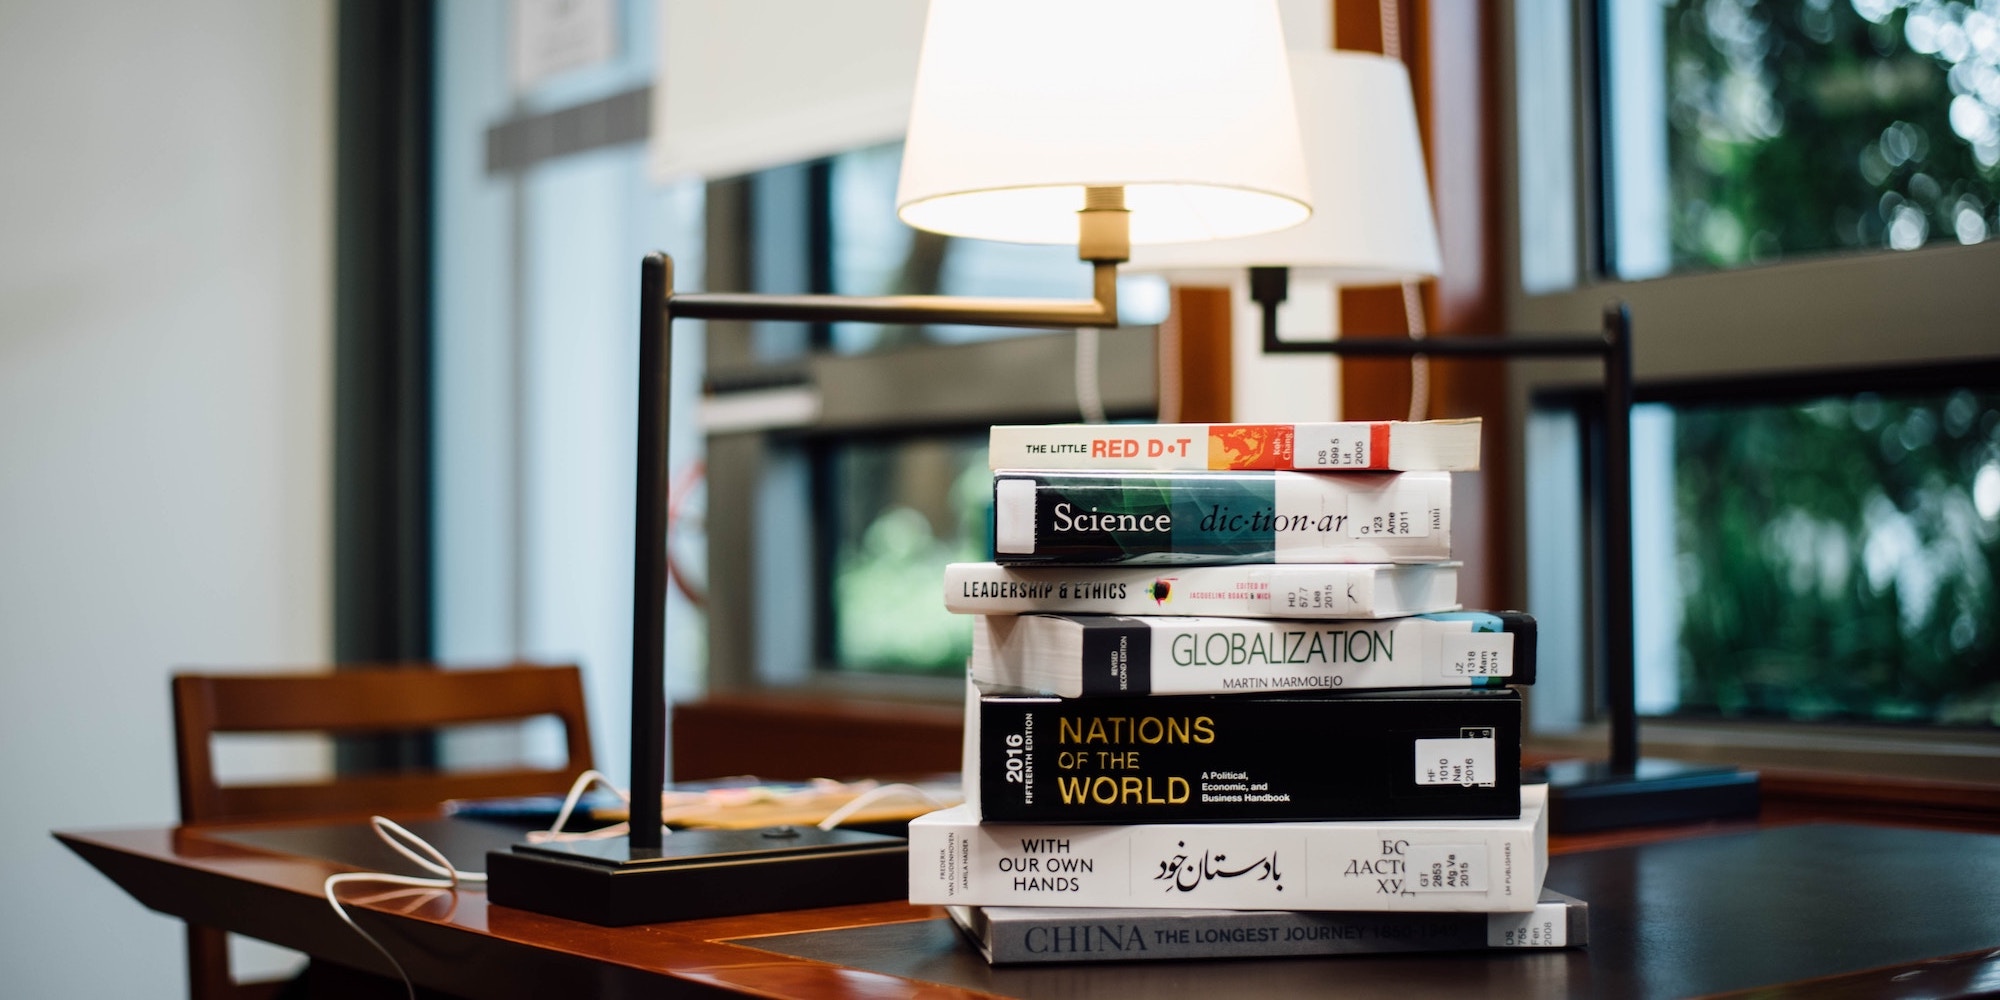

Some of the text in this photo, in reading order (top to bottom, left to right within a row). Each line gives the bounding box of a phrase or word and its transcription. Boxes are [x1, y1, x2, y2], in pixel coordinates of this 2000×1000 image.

[1026, 444, 1047, 454] THE
[1050, 444, 1088, 454] LITTLE
[1091, 439, 1140, 458] RED
[1273, 438, 1281, 456] Koh
[1355, 440, 1364, 465] 2005
[1318, 450, 1327, 465] DS
[1343, 453, 1352, 465] Lit
[1053, 503, 1171, 532] Science
[1374, 516, 1383, 534] 123
[1387, 511, 1396, 535] Ame
[1400, 511, 1409, 534] 2011
[1361, 526, 1370, 535] Q
[963, 581, 1127, 600] LEADERSHIP & ETHICS
[1236, 582, 1258, 590] EDITED
[1288, 592, 1296, 608] HD
[1312, 590, 1322, 608] Lea
[1324, 584, 1333, 608] 2015
[1171, 630, 1394, 666] GLOBALIZATION
[1456, 662, 1465, 674] JZ
[1467, 651, 1476, 673] 1318
[1491, 651, 1499, 674] 2014
[1223, 675, 1343, 690] MARTIN MARMOLEJO
[1059, 716, 1215, 744] NATIONS
[1006, 734, 1024, 783] 2016
[1025, 713, 1033, 804] FIFTEENTH EDITION
[1058, 751, 1140, 769] OF THE
[1201, 771, 1249, 781] A Political,
[1428, 768, 1436, 782] HF
[1439, 758, 1448, 781] 1010
[1453, 765, 1462, 782] Nat
[1465, 758, 1474, 782] 2016
[1057, 776, 1190, 805] WORLD
[1201, 782, 1268, 792] Economic, and
[1201, 793, 1291, 803] Business Handbook
[1021, 839, 1070, 853] WITH
[999, 858, 1094, 872] OUR OWN
[1344, 859, 1406, 877] ДАСТ
[1420, 872, 1429, 887] GT
[1432, 863, 1442, 887] 2853
[1461, 862, 1470, 887] 2015
[1014, 877, 1080, 892] HANDS
[1024, 925, 1148, 953] CHINA
[1154, 929, 1190, 944] THE
[1196, 927, 1279, 943] LONGEST
[1284, 926, 1365, 941] JOURNEY
[1505, 930, 1514, 946] DS
[1517, 927, 1527, 945] 755
[1531, 927, 1540, 945] Fen
[1543, 921, 1552, 945] 2008
